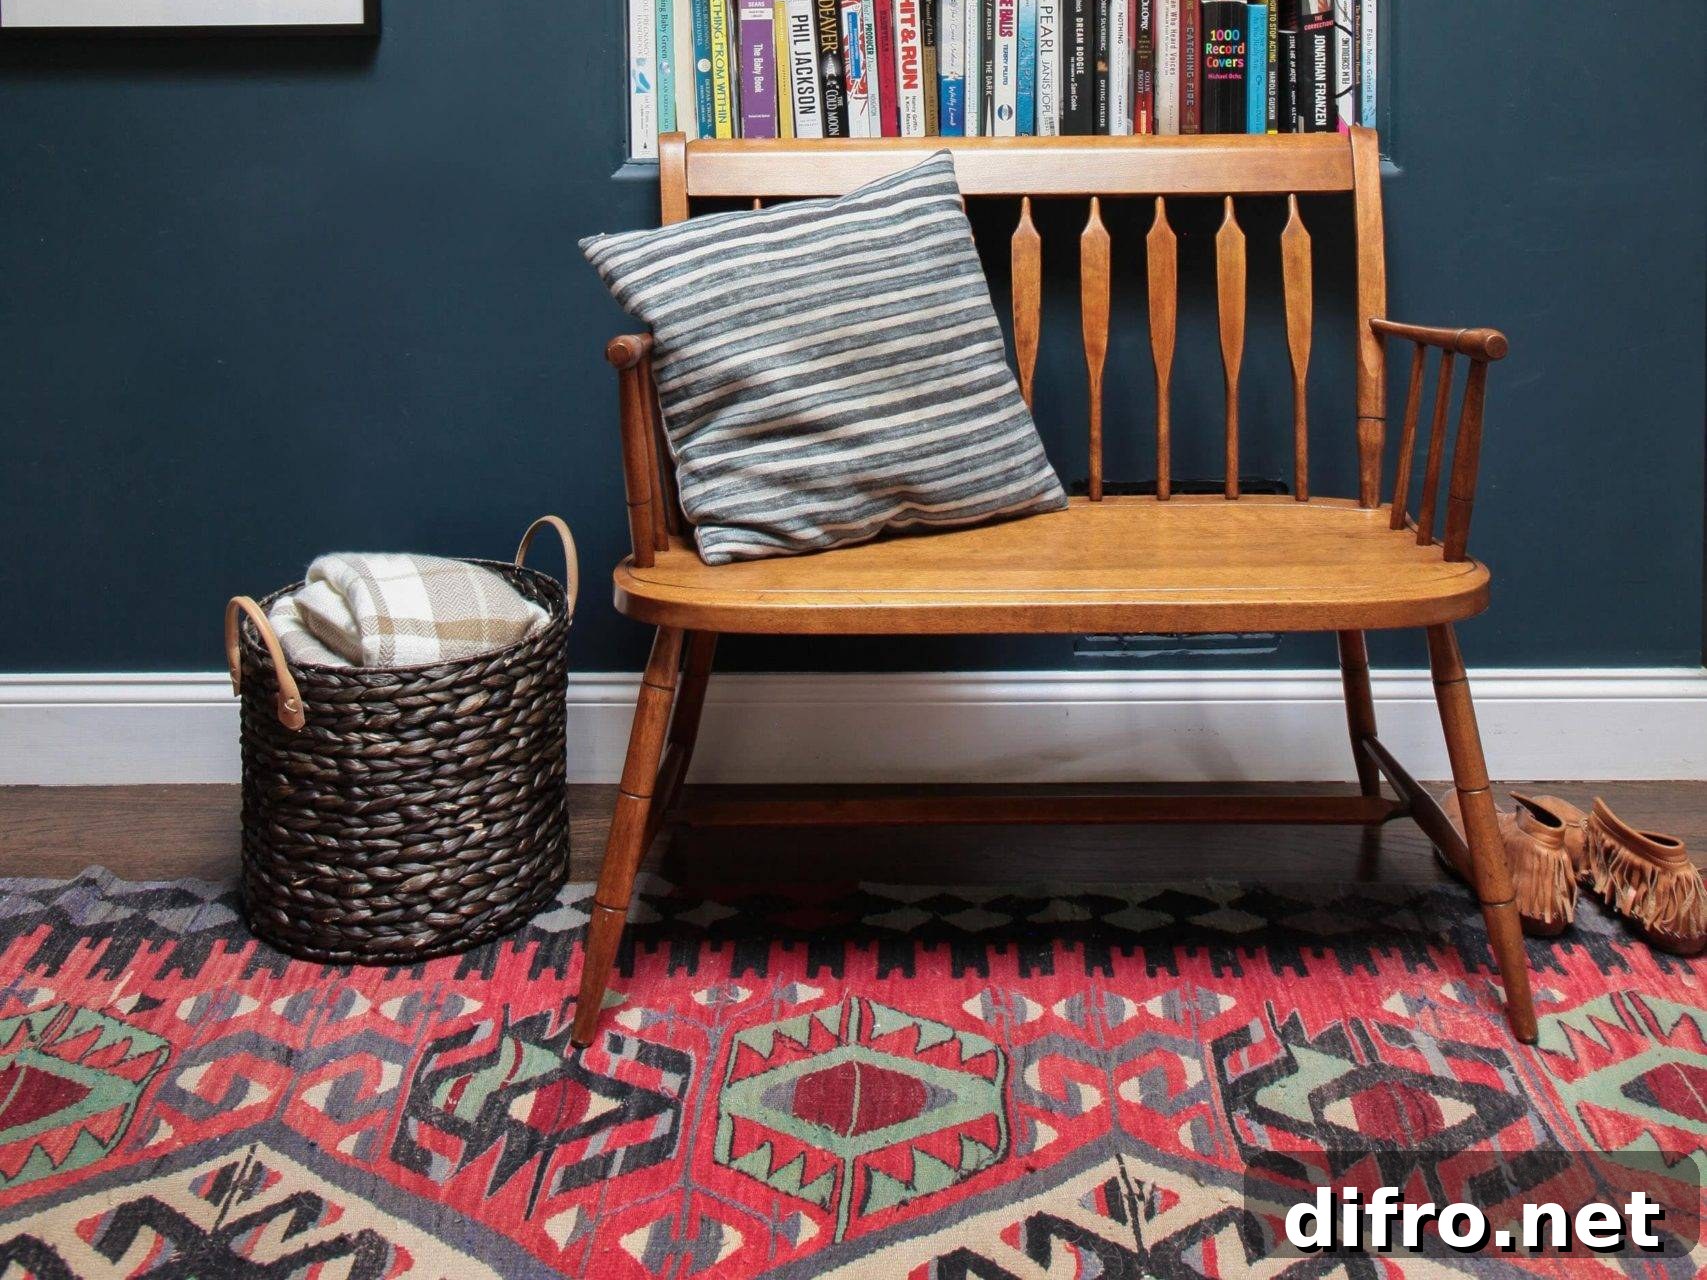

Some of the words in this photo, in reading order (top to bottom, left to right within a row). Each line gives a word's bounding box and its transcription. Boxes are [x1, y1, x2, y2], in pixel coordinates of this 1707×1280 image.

[660, 13, 669, 33] Baby
[791, 14, 810, 45] PHIL
[999, 8, 1014, 38] BALLS
[1170, 11, 1178, 26] Who
[1268, 13, 1276, 23] TO
[864, 23, 873, 56] PRODUCER
[1039, 5, 1053, 56] PEARL
[1075, 17, 1083, 44] DREAM
[1210, 29, 1241, 41] 1000
[1268, 23, 1276, 40] STOP
[660, 35, 669, 60] Green
[752, 43, 763, 57] The
[1186, 27, 1194, 78] CATCHING
[1205, 42, 1245, 54] Record
[1268, 40, 1276, 63] ACTING
[1314, 33, 1326, 81] JONATHAN
[714, 42, 725, 79] FROM
[752, 57, 763, 75] Baby
[902, 46, 919, 90] RUN
[985, 60, 993, 73] THE
[1075, 46, 1083, 75] BOOGIE
[1170, 52, 1178, 76] Voices
[1206, 56, 1245, 68] Covers
[752, 76, 763, 93] Book
[794, 50, 816, 116] JACKSON
[985, 74, 993, 96] DARK
[1041, 59, 1051, 90] JANIS
[1268, 71, 1276, 96] HAROLD
[716, 81, 728, 124] WITHIN
[825, 89, 838, 110] COLD
[1041, 91, 1051, 115] JOPL
[1186, 82, 1194, 106] FIRE
[1314, 82, 1327, 126] FRANZEN
[1268, 97, 1276, 120] GUSKIN
[827, 111, 840, 136] MOON
